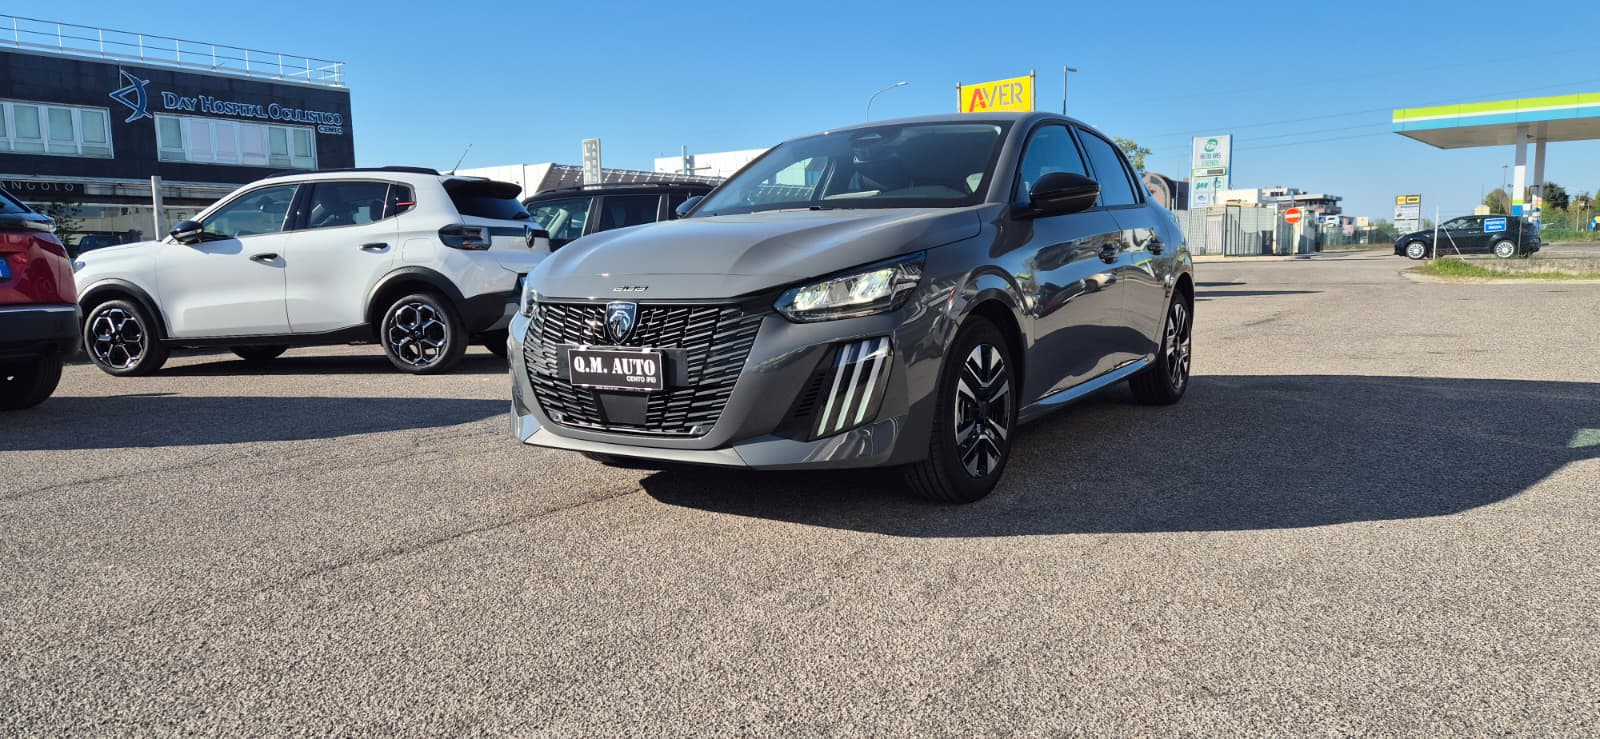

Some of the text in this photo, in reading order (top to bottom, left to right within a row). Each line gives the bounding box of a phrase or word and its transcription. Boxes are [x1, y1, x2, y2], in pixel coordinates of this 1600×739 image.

[969, 82, 1024, 112] AVER
[161, 91, 343, 126] DAY HOSPITAL OCULISTICO
[317, 124, 343, 135] CENTO
[573, 355, 656, 376] Q.M. AUTO
[626, 375, 645, 383] CENTO
